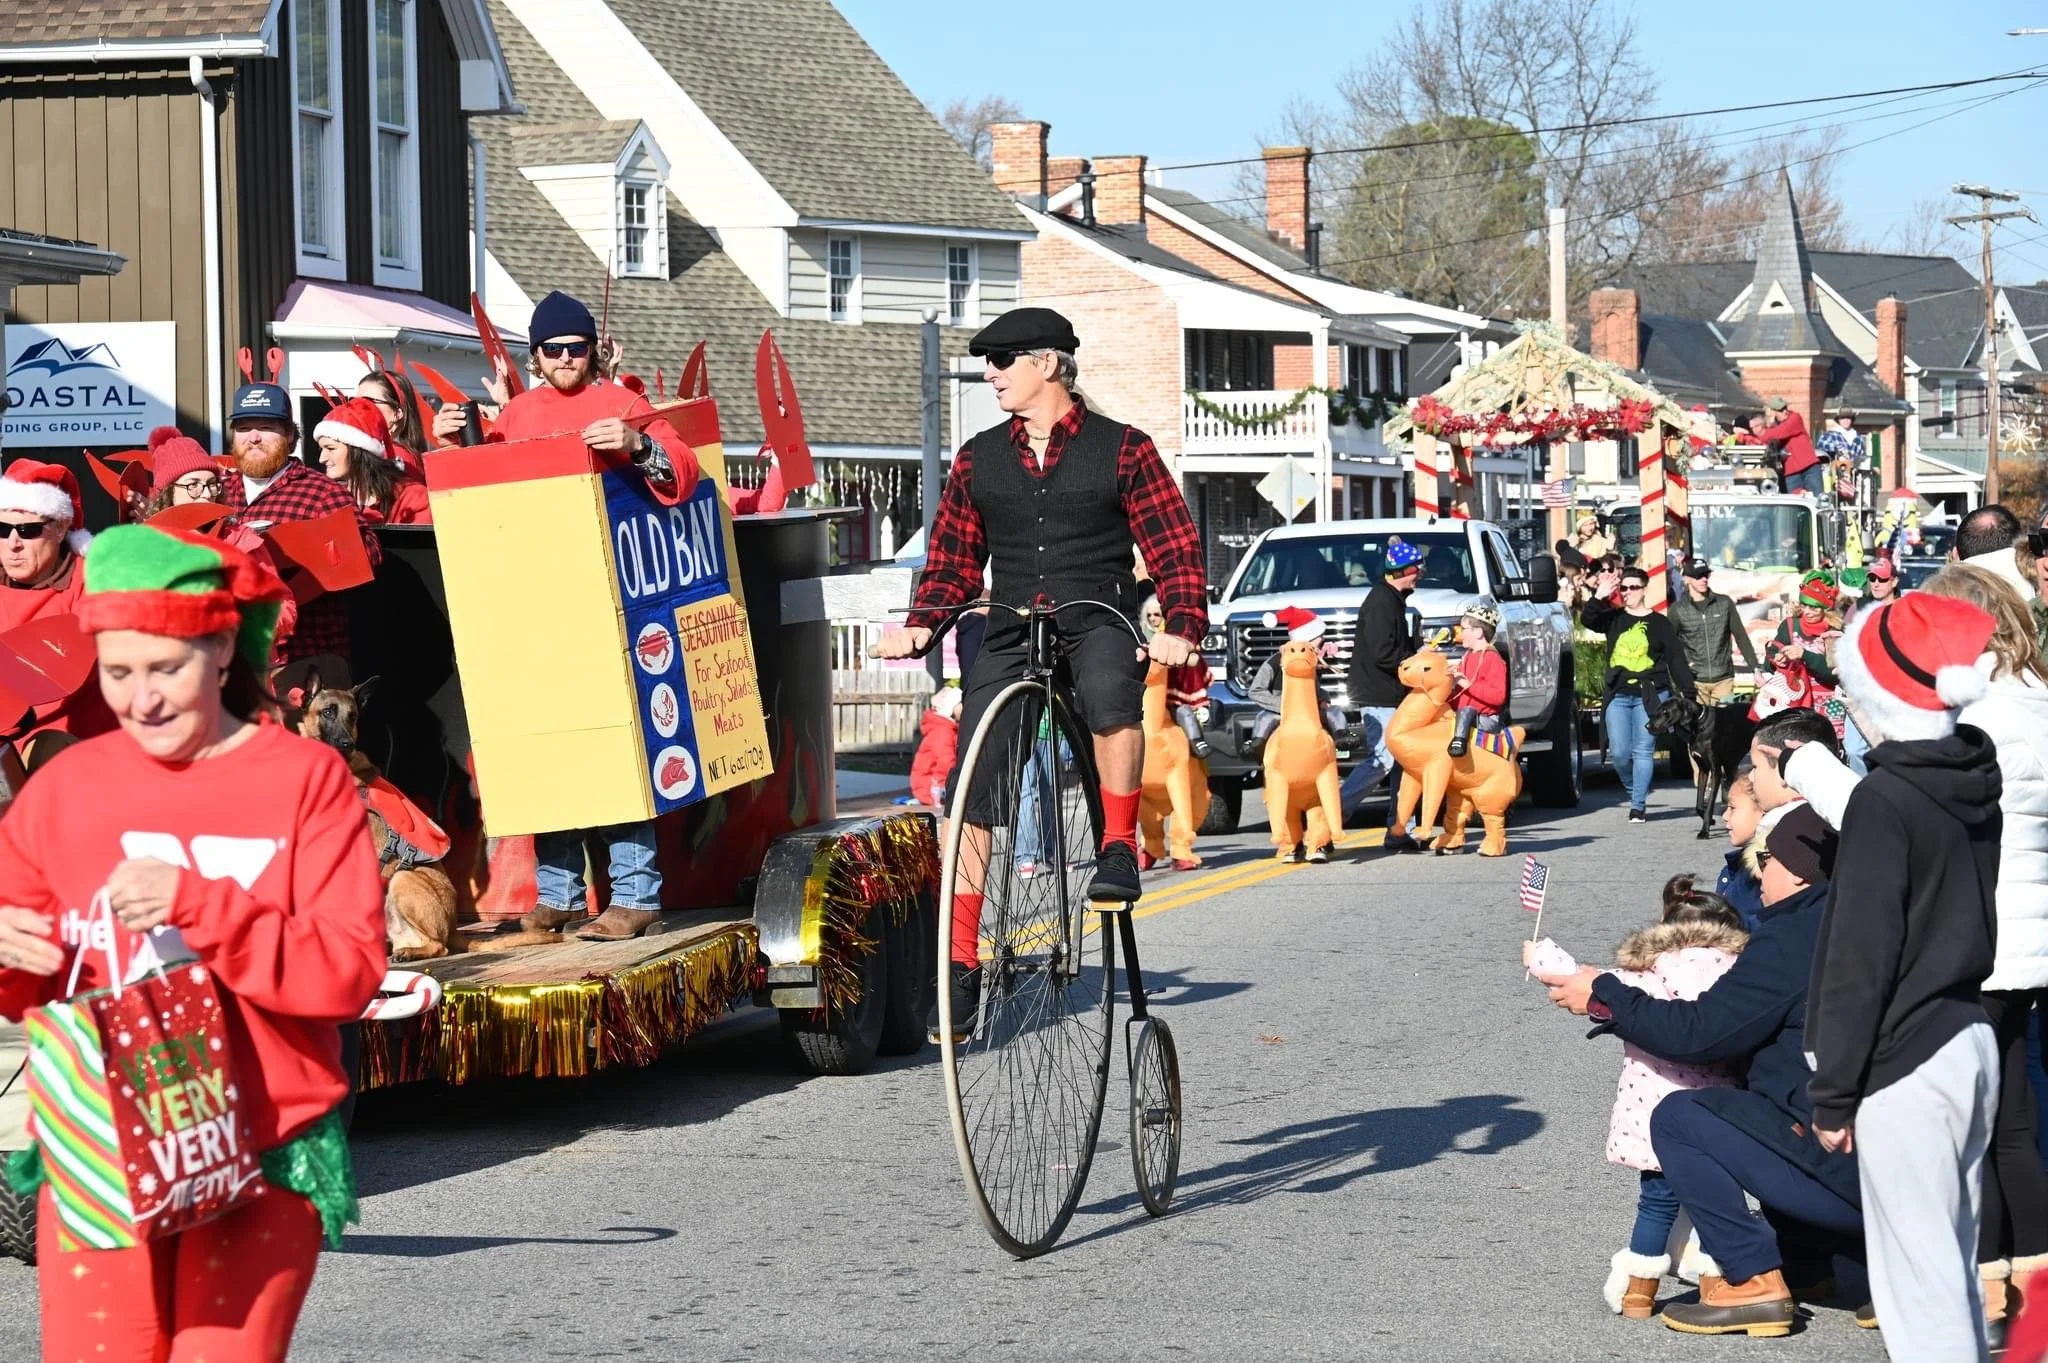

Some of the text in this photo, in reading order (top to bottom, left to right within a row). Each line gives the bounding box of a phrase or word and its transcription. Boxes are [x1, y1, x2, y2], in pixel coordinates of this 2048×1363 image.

[7, 385, 146, 408] OASTAL
[0, 421, 144, 433] DING GROUP, LLC
[617, 497, 719, 599] OLD BAY
[680, 600, 744, 652] SEASONING
[695, 658, 711, 684] For
[692, 687, 727, 715] Poultry,
[713, 712, 744, 736] Meats
[708, 755, 727, 782] NET
[119, 1031, 211, 1092] VERY
[135, 1067, 228, 1137] VERY
[148, 1111, 238, 1182] VERY
